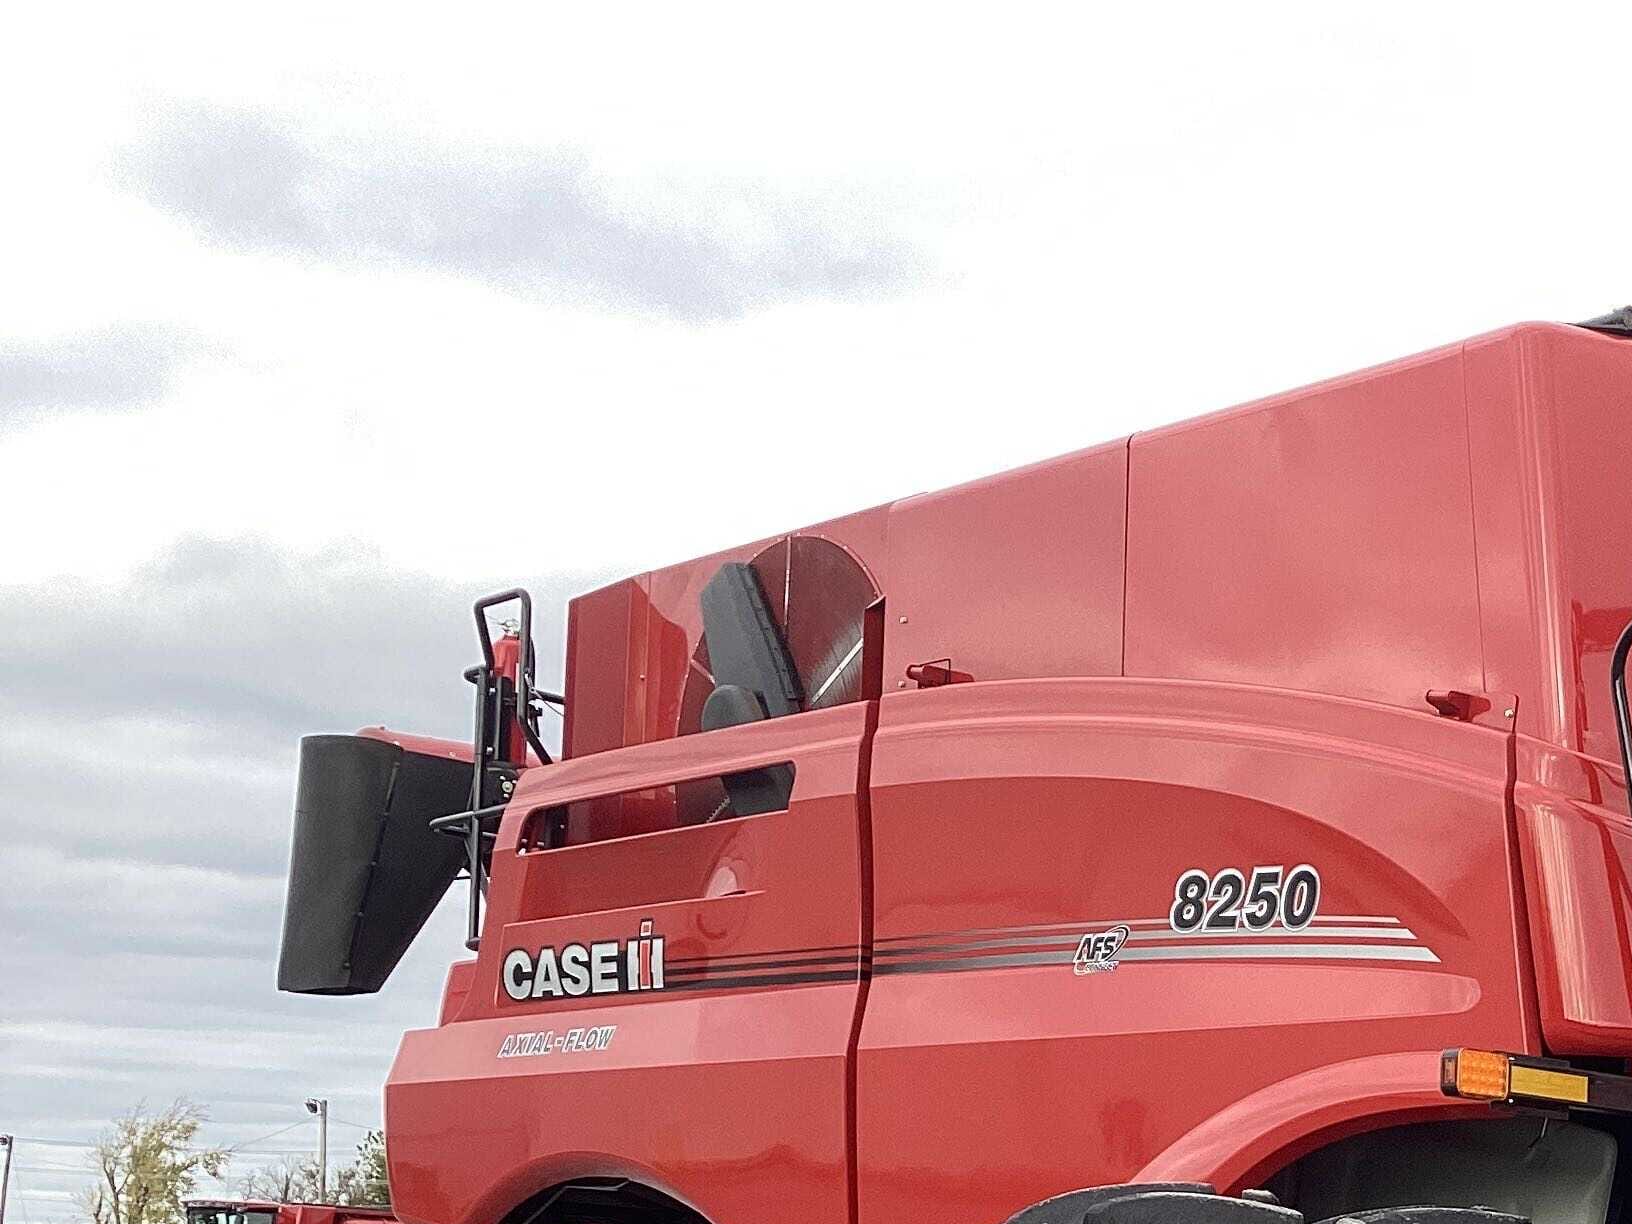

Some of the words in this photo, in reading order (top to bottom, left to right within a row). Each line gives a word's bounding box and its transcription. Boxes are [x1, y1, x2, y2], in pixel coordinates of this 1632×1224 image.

[1170, 864, 1321, 933] 8250
[502, 940, 619, 1001] CASE
[1074, 933, 1118, 962] AFS
[497, 1024, 617, 1058] AXIAL-FLOW
